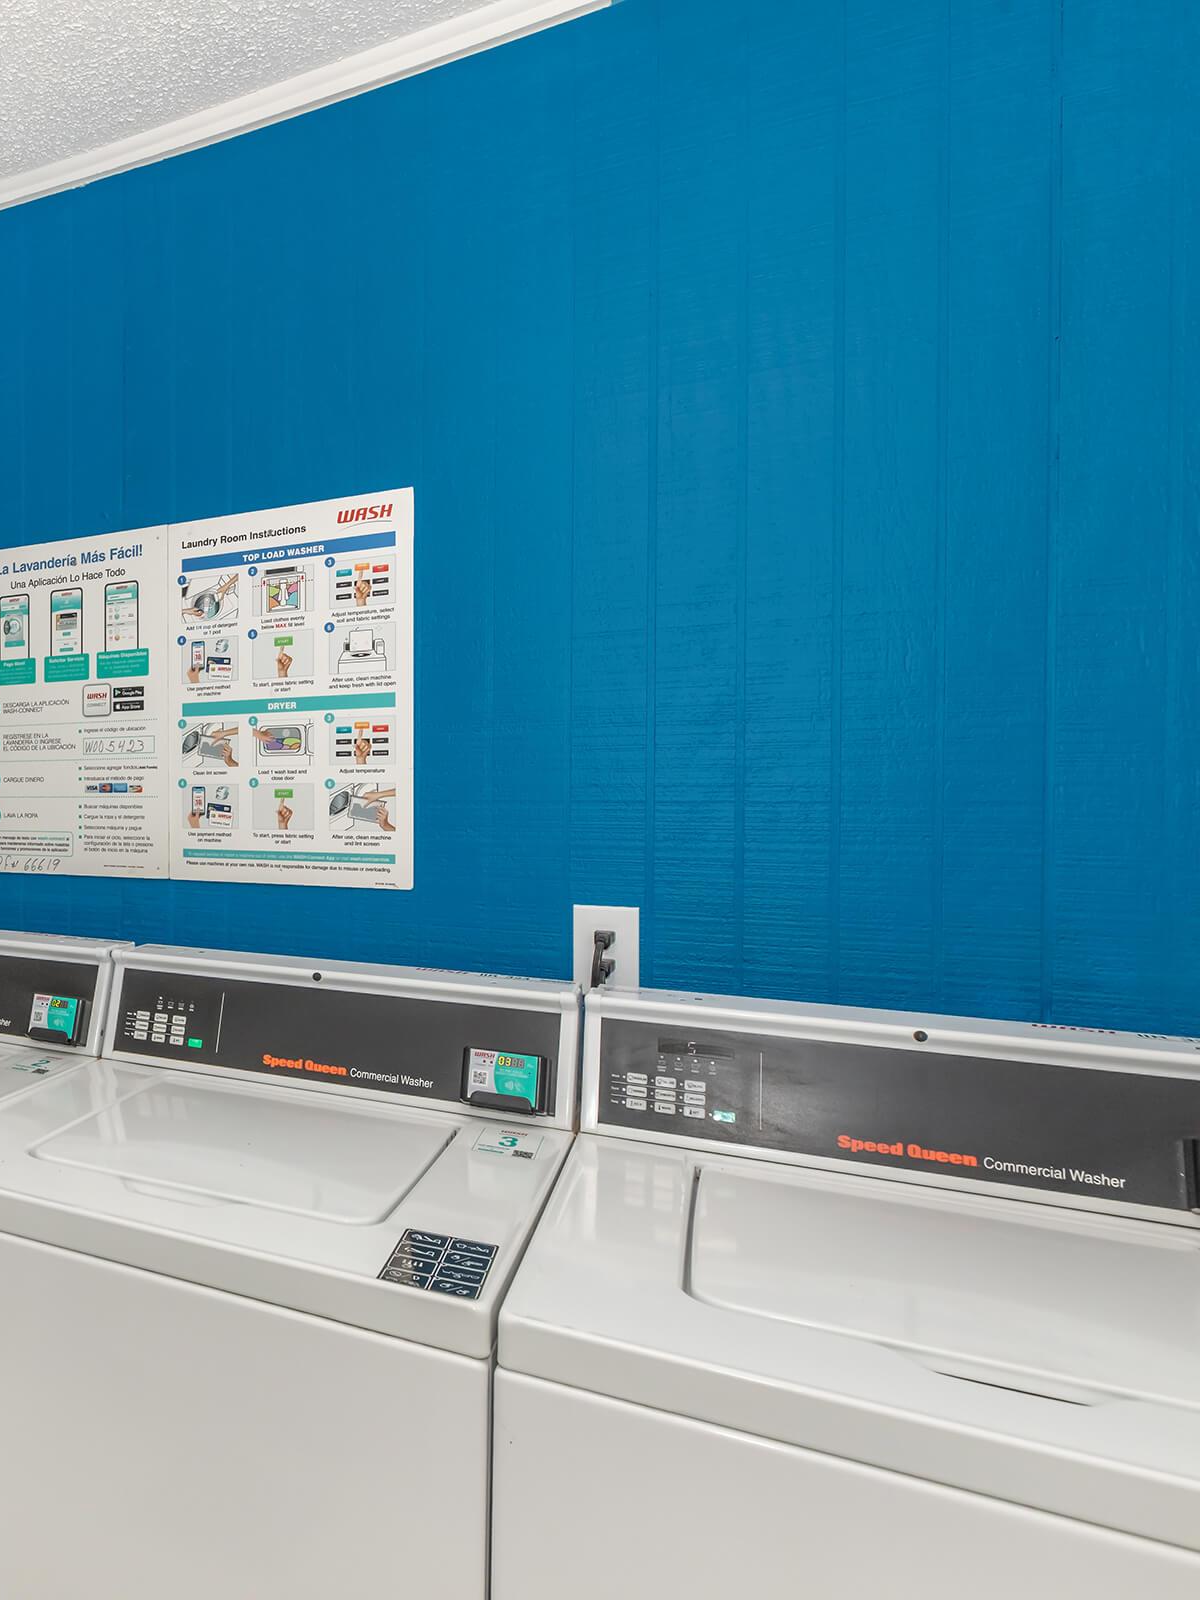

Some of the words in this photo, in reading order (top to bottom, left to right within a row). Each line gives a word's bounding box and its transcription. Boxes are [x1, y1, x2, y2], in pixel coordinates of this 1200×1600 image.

[336, 504, 393, 524] WASH
[182, 536, 218, 550] Laundry
[220, 533, 247, 545] Room
[13, 554, 77, 574] Lavandería
[81, 551, 106, 564] Más
[110, 544, 143, 560] Fácil!
[242, 553, 260, 562] TOP
[262, 551, 285, 560] LOAD
[287, 545, 325, 558] WASHER
[11, 580, 26, 589] Una
[28, 575, 67, 588] Aplicación
[70, 574, 80, 582] Lo
[82, 572, 103, 581] Hace
[105, 567, 125, 578] Todo
[347, 609, 378, 617] temperature,
[371, 614, 390, 622] settings
[268, 702, 296, 710] DRYER
[24, 858, 61, 872] 66619
[262, 1054, 303, 1072] Speed
[305, 1059, 347, 1076] Queen
[350, 1067, 398, 1084] Commercial
[401, 1073, 433, 1088] Washer
[498, 1136, 518, 1147] 3
[837, 1134, 904, 1156] Speed
[907, 1143, 978, 1166] Queen
[983, 1156, 1066, 1180] Commercial
[1069, 1166, 1126, 1189] Washer
